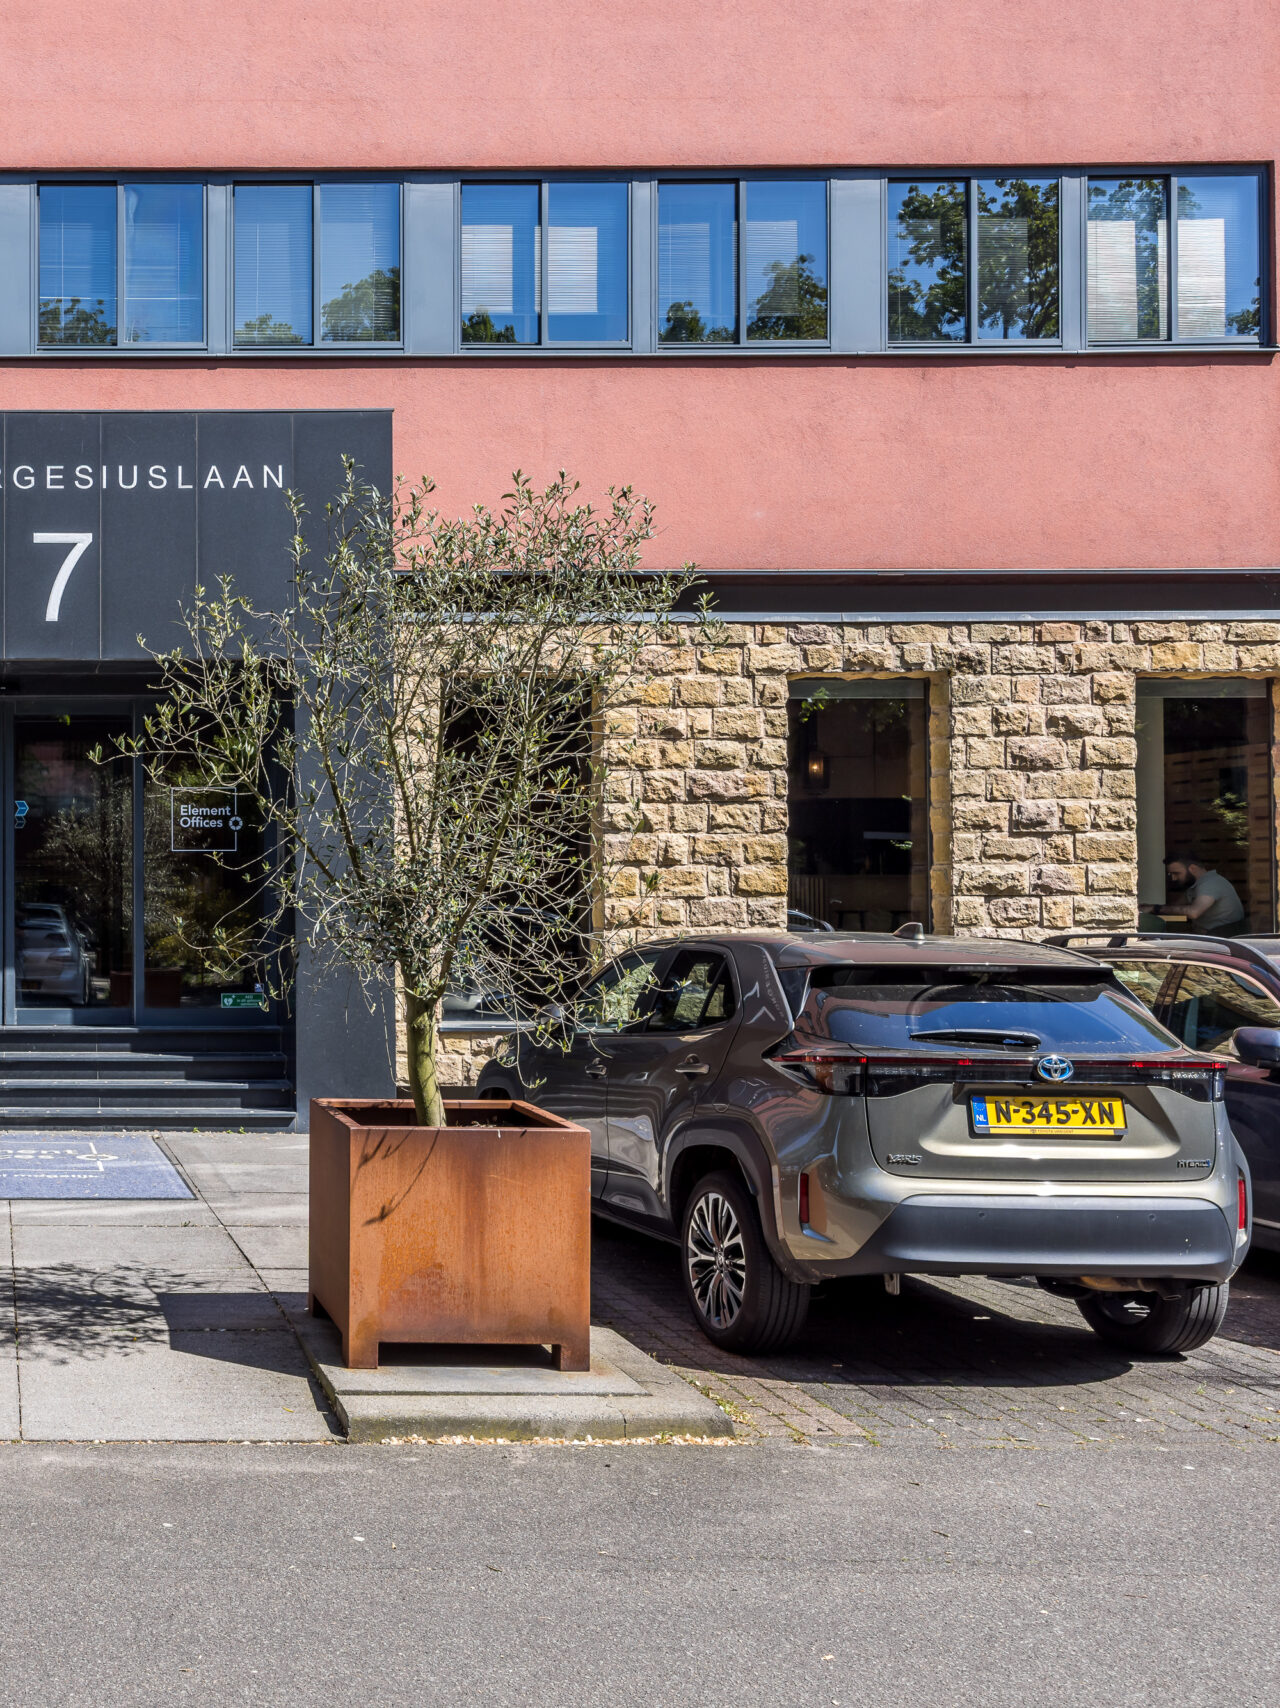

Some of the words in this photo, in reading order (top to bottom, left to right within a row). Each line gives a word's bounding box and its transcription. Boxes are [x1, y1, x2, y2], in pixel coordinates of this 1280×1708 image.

[180, 804, 231, 816] Element
[180, 816, 223, 828] Offices
[994, 1100, 1115, 1125] N-345-XN
